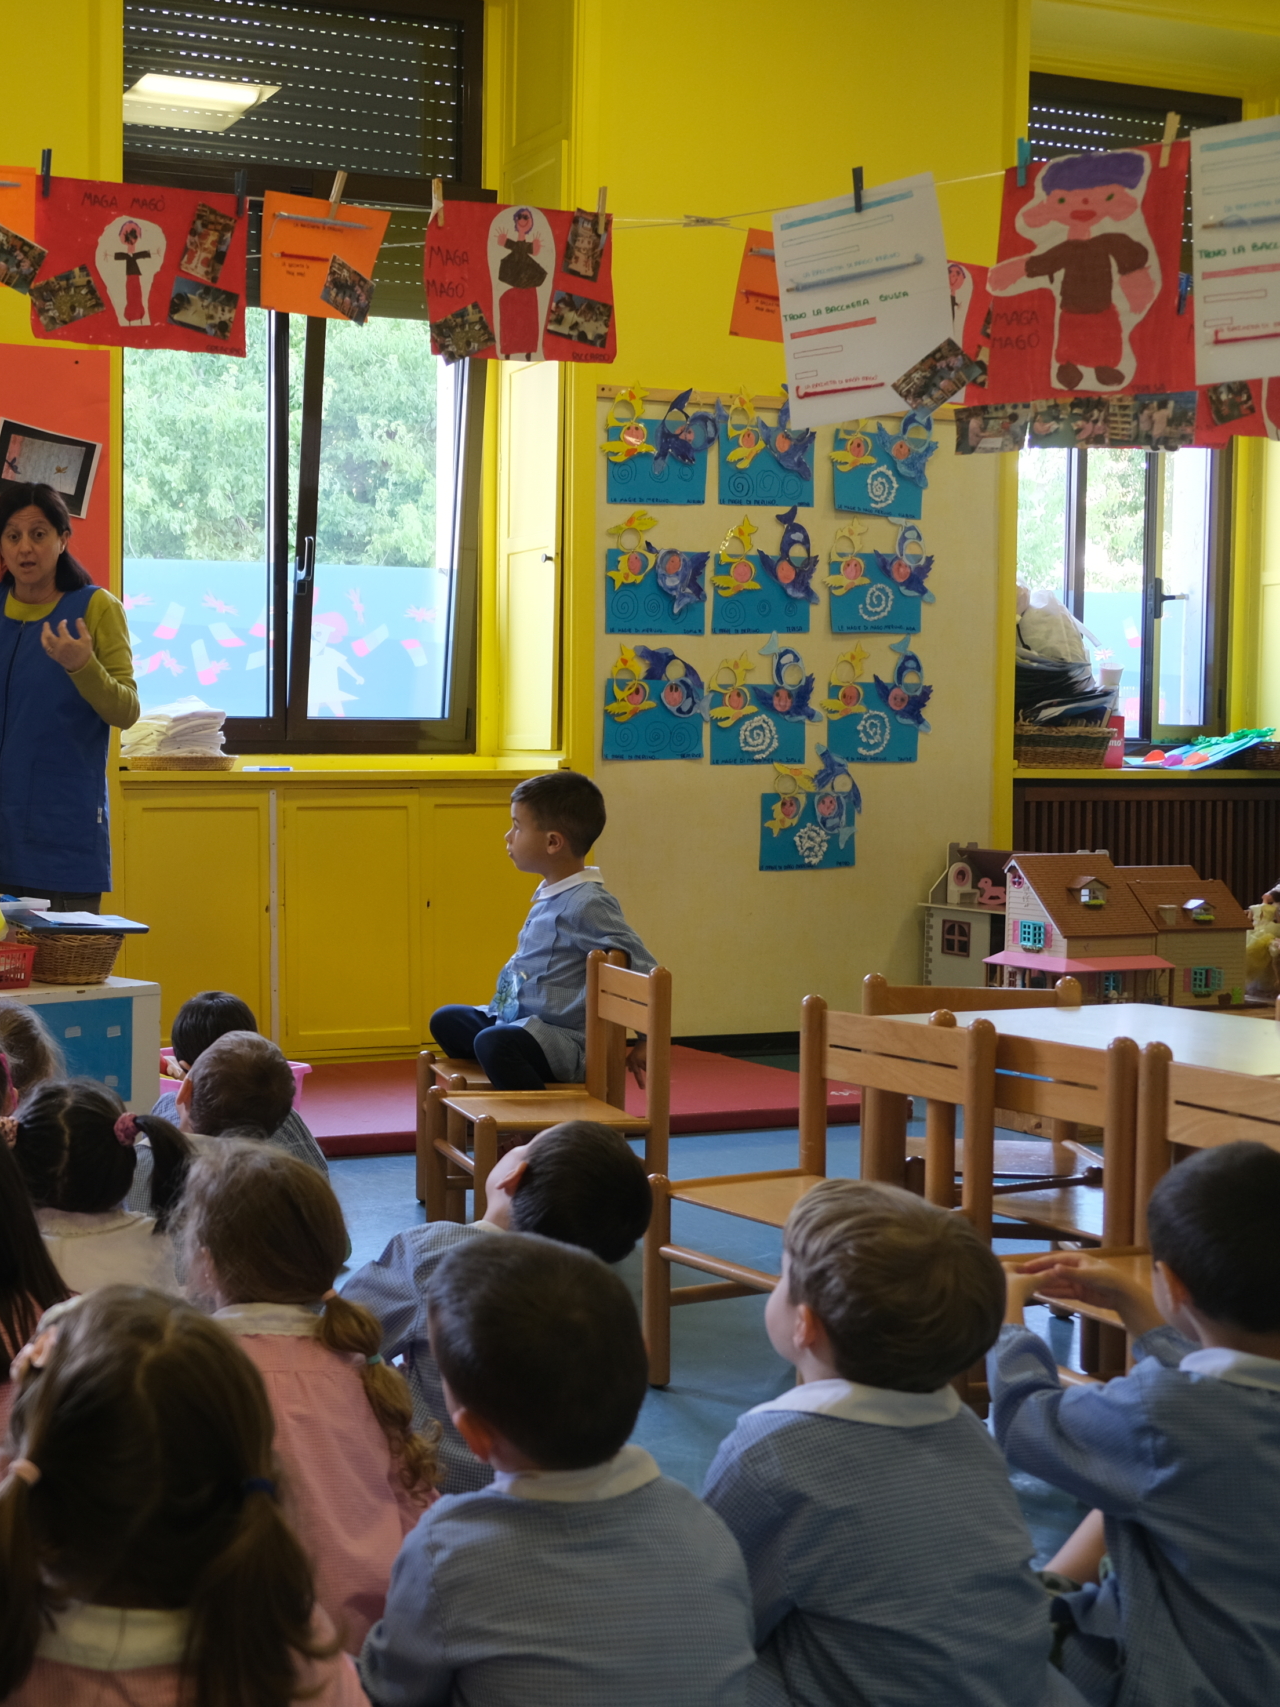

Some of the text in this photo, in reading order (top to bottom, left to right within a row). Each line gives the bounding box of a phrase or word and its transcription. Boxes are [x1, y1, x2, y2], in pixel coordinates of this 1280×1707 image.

[81, 192, 167, 212] MAGA MAGÒ
[428, 245, 469, 268] MAGA
[426, 276, 468, 299] MAGÒ
[812, 308, 822, 316] LA
[994, 310, 1040, 326] MAGA
[992, 330, 1041, 350] MAGÒ
